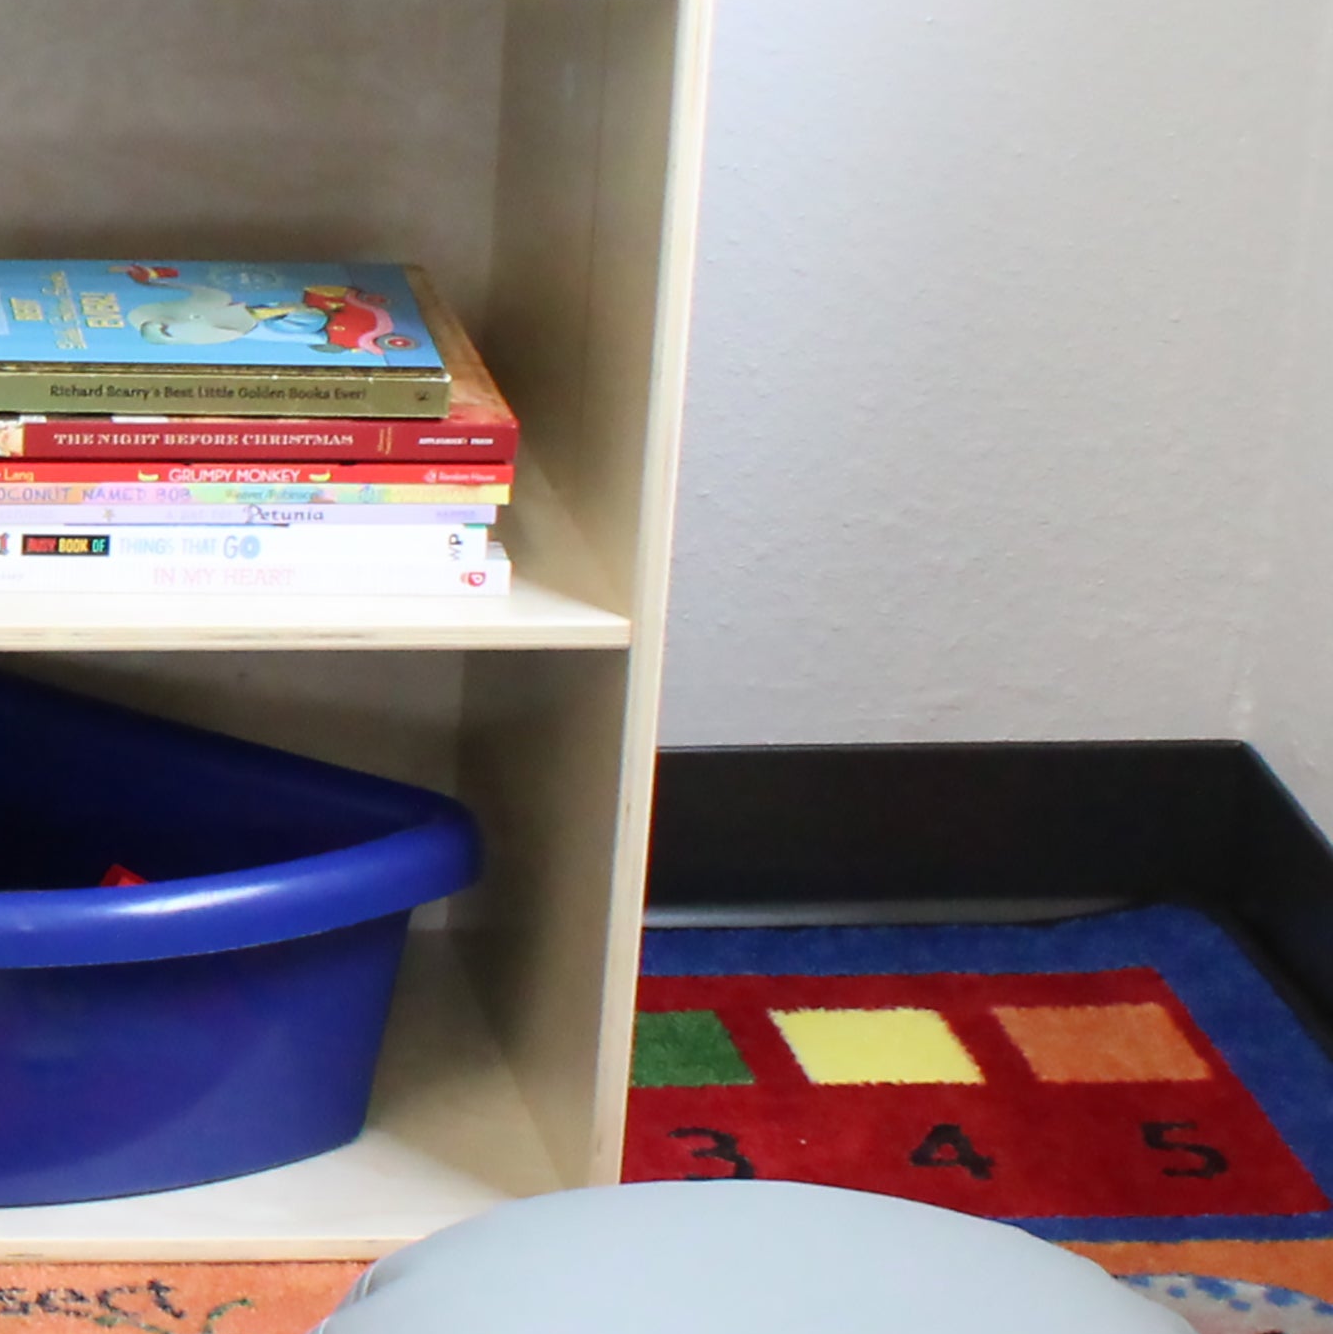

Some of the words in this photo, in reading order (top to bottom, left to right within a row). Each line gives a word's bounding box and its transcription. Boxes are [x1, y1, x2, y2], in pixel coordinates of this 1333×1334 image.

[49, 385, 104, 398] Richard
[106, 386, 160, 401] Scarry's
[163, 386, 194, 398] Best
[197, 386, 234, 399] Little
[238, 387, 286, 399] Golden
[289, 387, 331, 400] Books
[334, 387, 367, 400] Ever!
[53, 433, 94, 445] THE
[97, 433, 160, 445] NIGHT
[163, 433, 238, 446] BEFORE
[242, 433, 354, 446] CHRISTMAS
[3, 469, 35, 483] Lang
[168, 468, 232, 483] GRUMPY
[236, 468, 301, 483] MONKEY
[82, 487, 147, 501] NAMED
[155, 487, 192, 500] BOB
[244, 503, 325, 525] Petunia
[58, 536, 89, 552] BOOK
[91, 536, 107, 552] OF
[119, 537, 175, 556] THINGS
[181, 537, 217, 556] THAT
[223, 534, 261, 560] GO
[152, 567, 176, 585] IN
[182, 567, 215, 587] MY
[224, 567, 296, 586] HEART
[668, 1126, 755, 1180] 3
[908, 1122, 996, 1180] 4
[1139, 1120, 1231, 1180] 5
